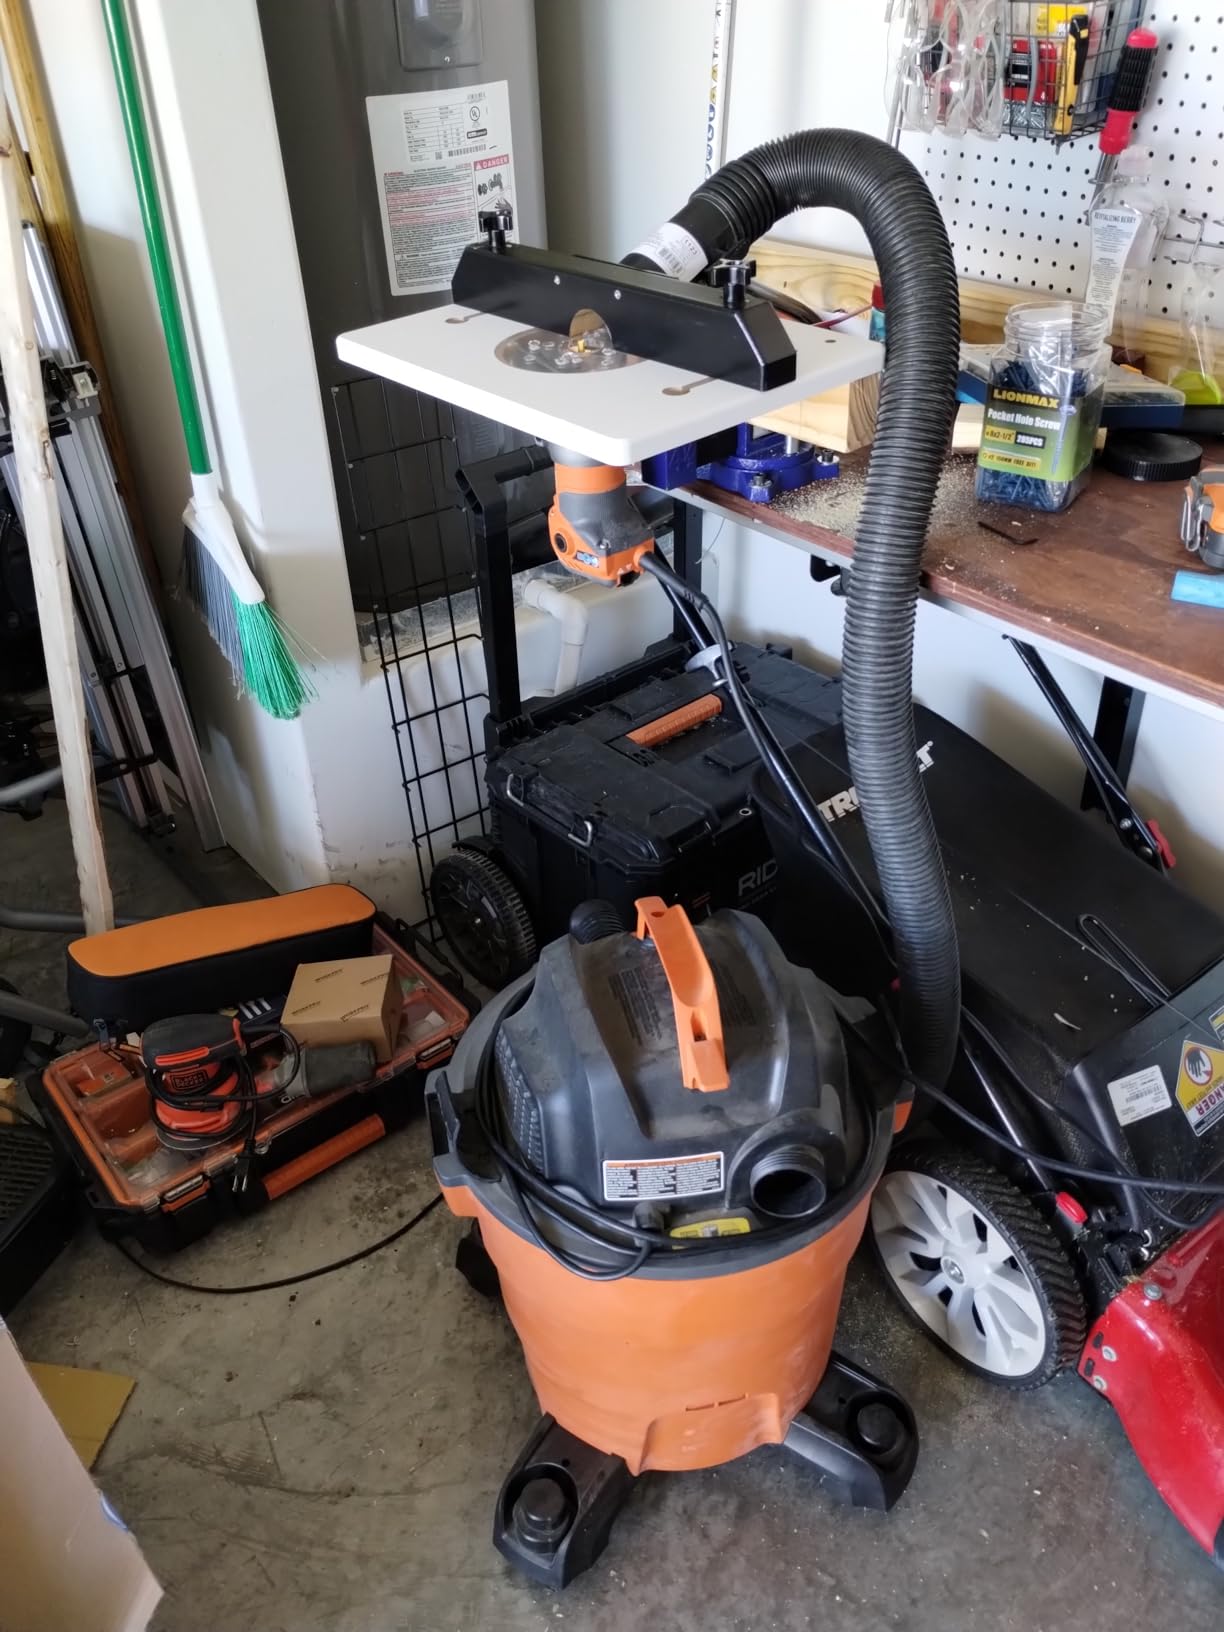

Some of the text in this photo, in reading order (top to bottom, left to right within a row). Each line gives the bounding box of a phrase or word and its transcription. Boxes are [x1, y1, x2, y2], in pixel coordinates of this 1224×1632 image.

[993, 388, 1060, 409] LIONMAX
[987, 408, 1061, 431] Pocket Hole Screw
